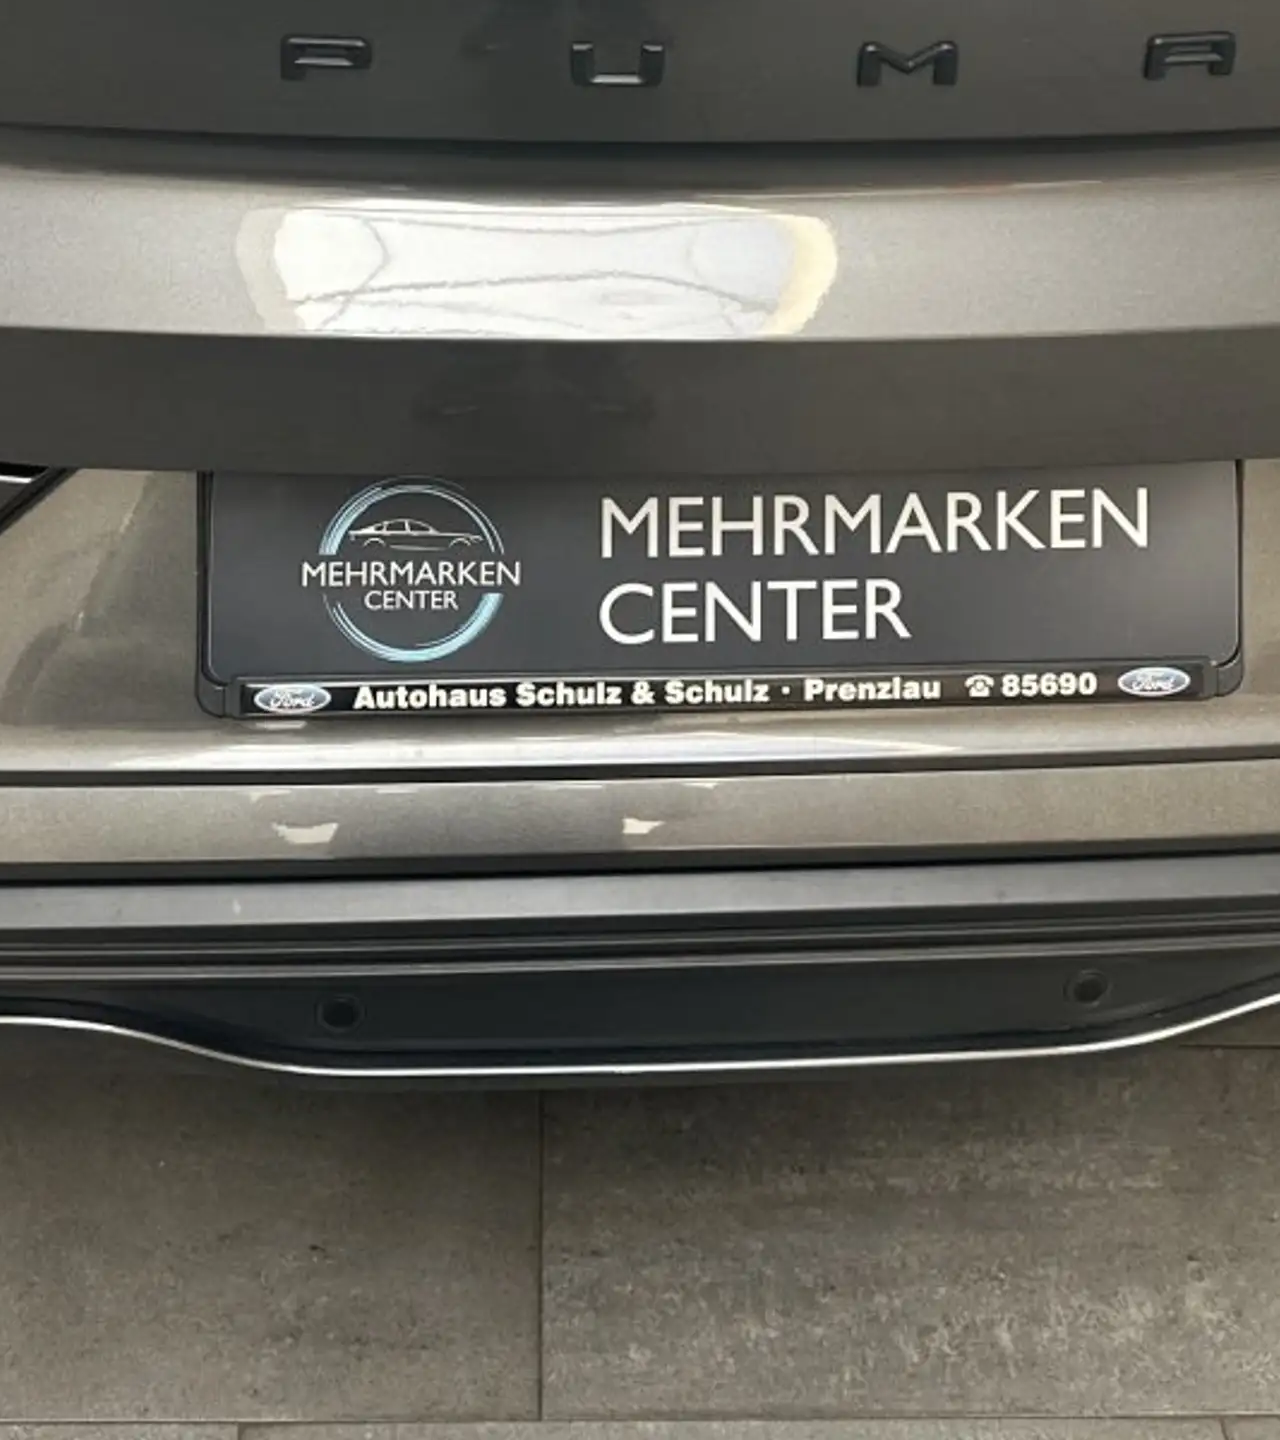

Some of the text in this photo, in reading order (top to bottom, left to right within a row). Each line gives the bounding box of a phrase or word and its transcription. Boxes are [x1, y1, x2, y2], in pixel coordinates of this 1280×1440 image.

[279, 31, 1237, 88] PUMA
[601, 487, 1148, 558] MEHRMARKEN
[301, 561, 521, 587] MEHRMARKEN
[364, 590, 459, 611] CENTER
[599, 578, 913, 645] CENTER
[353, 672, 1098, 709] Autohaus Schulz & Schulz Prenzlau 85690
